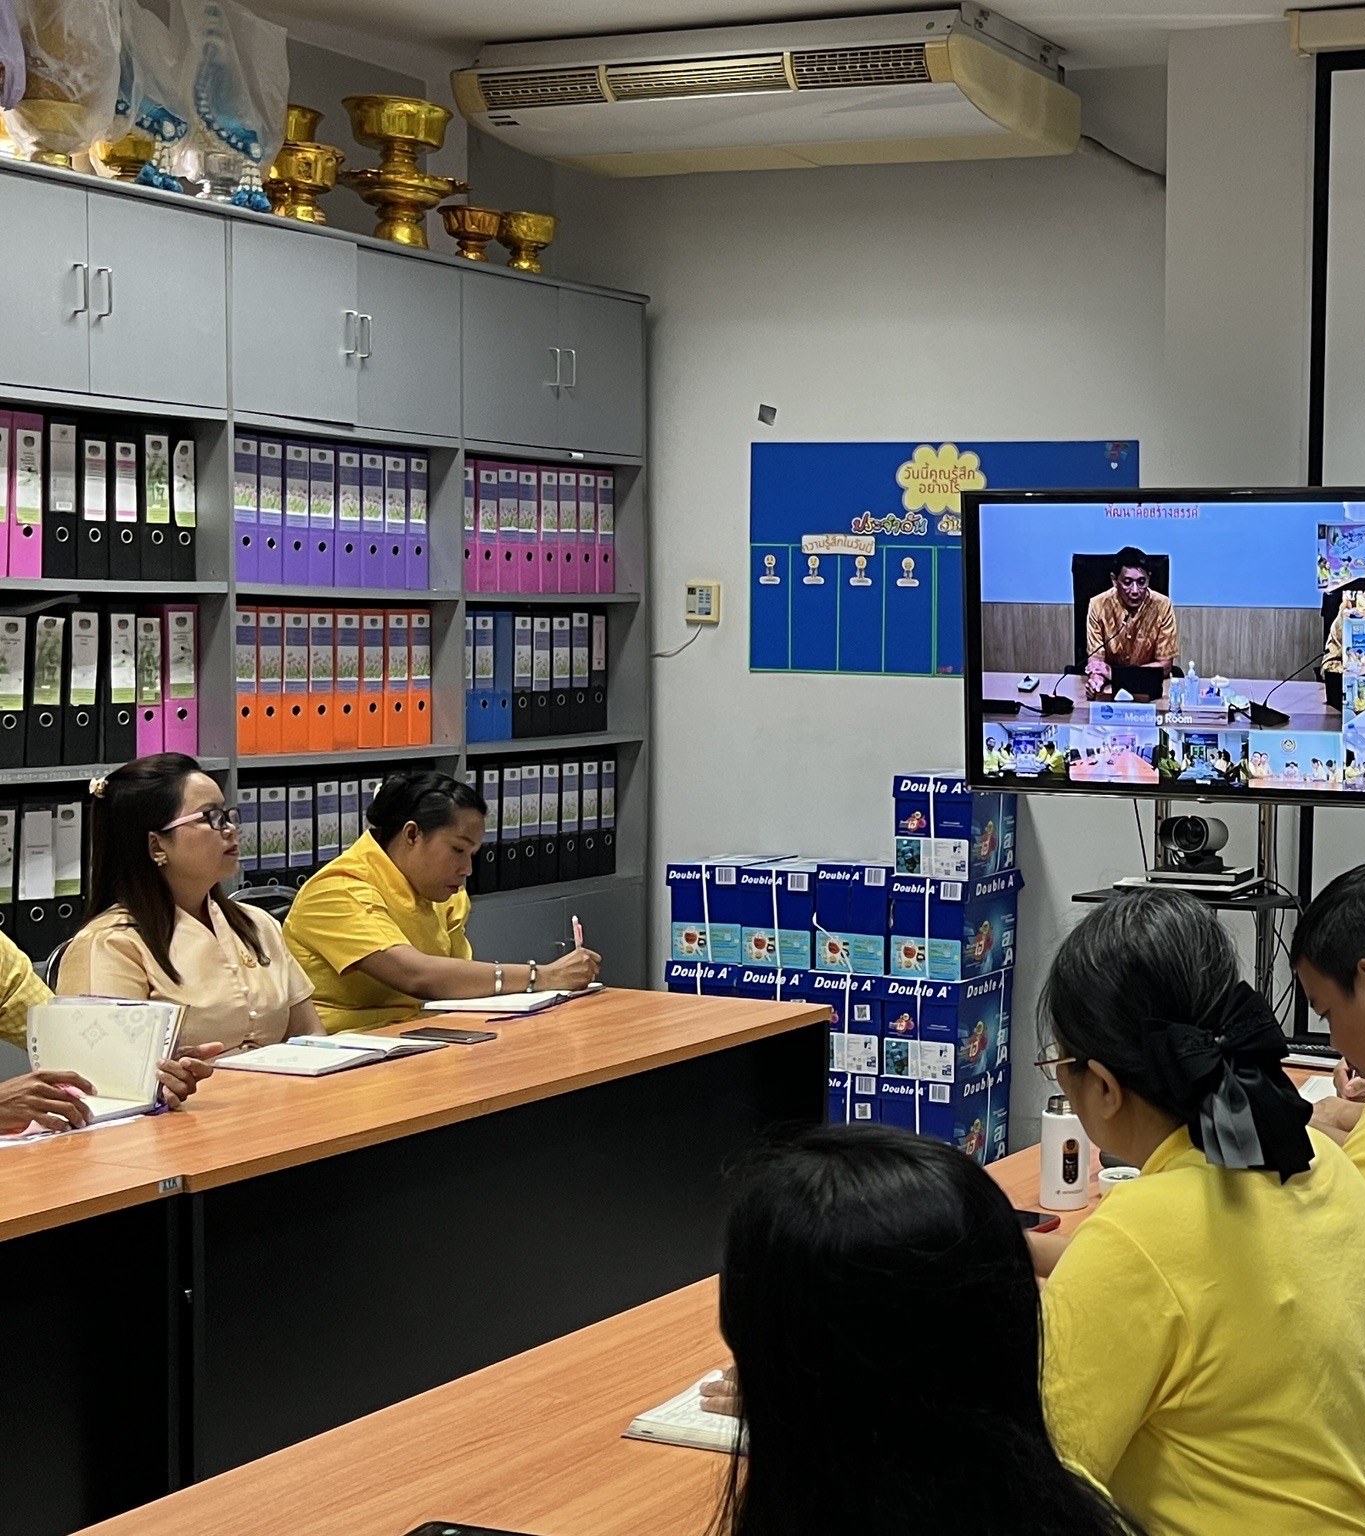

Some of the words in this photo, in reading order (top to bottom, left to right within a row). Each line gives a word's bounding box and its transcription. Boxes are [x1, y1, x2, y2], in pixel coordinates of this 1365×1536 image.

[1125, 712, 1163, 725] Meeting
[1165, 713, 1193, 724] Room
[951, 782, 962, 794] A
[669, 870, 700, 879] Double
[741, 875, 773, 885] Double
[774, 877, 783, 885] A
[819, 871, 850, 881] Double
[852, 871, 860, 881] A
[893, 883, 926, 893] Double
[928, 885, 935, 894] A
[976, 878, 1005, 896] Double
[1007, 875, 1014, 888] A
[717, 967, 727, 979] A
[789, 974, 799, 985] A
[861, 979, 871, 991] A
[937, 986, 947, 998] A
[967, 980, 996, 998] Double
[997, 1071, 1003, 1083] A
[882, 1083, 914, 1095] Double
